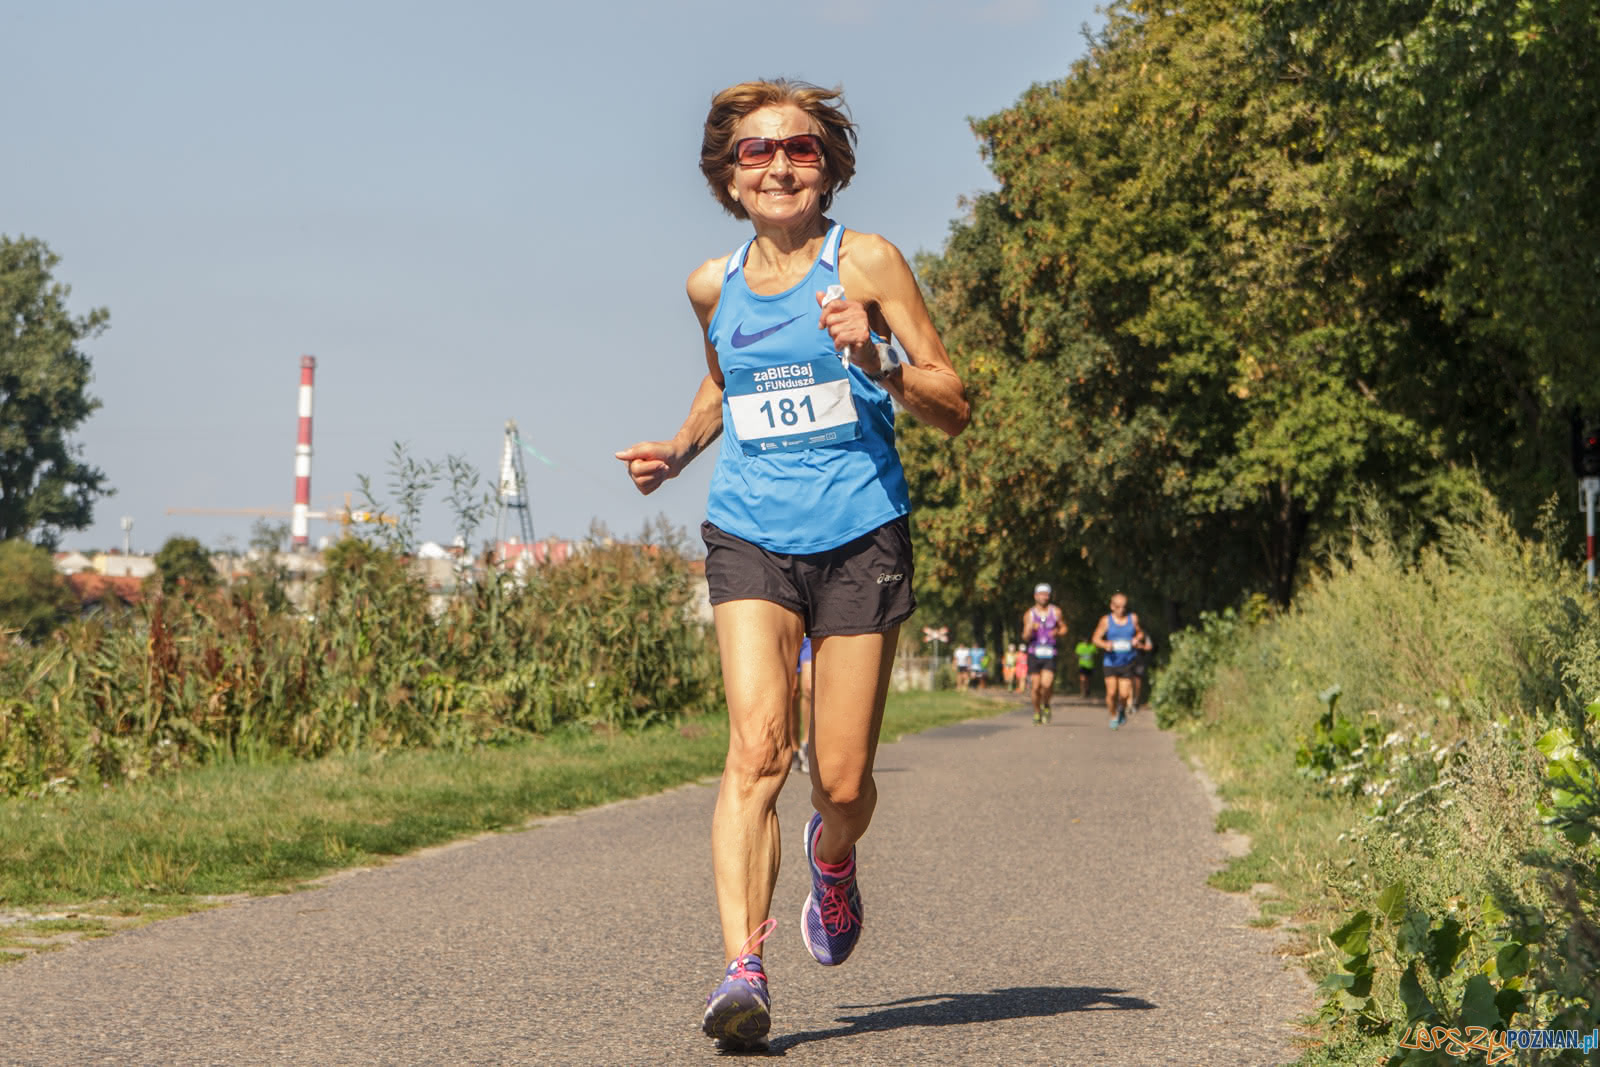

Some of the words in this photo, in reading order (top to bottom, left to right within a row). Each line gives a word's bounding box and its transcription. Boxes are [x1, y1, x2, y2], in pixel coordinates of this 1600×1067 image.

[753, 363, 813, 382] zaBIEGaj
[756, 384, 763, 392] o
[765, 377, 815, 391] FUNdusze
[760, 394, 816, 429] 181
